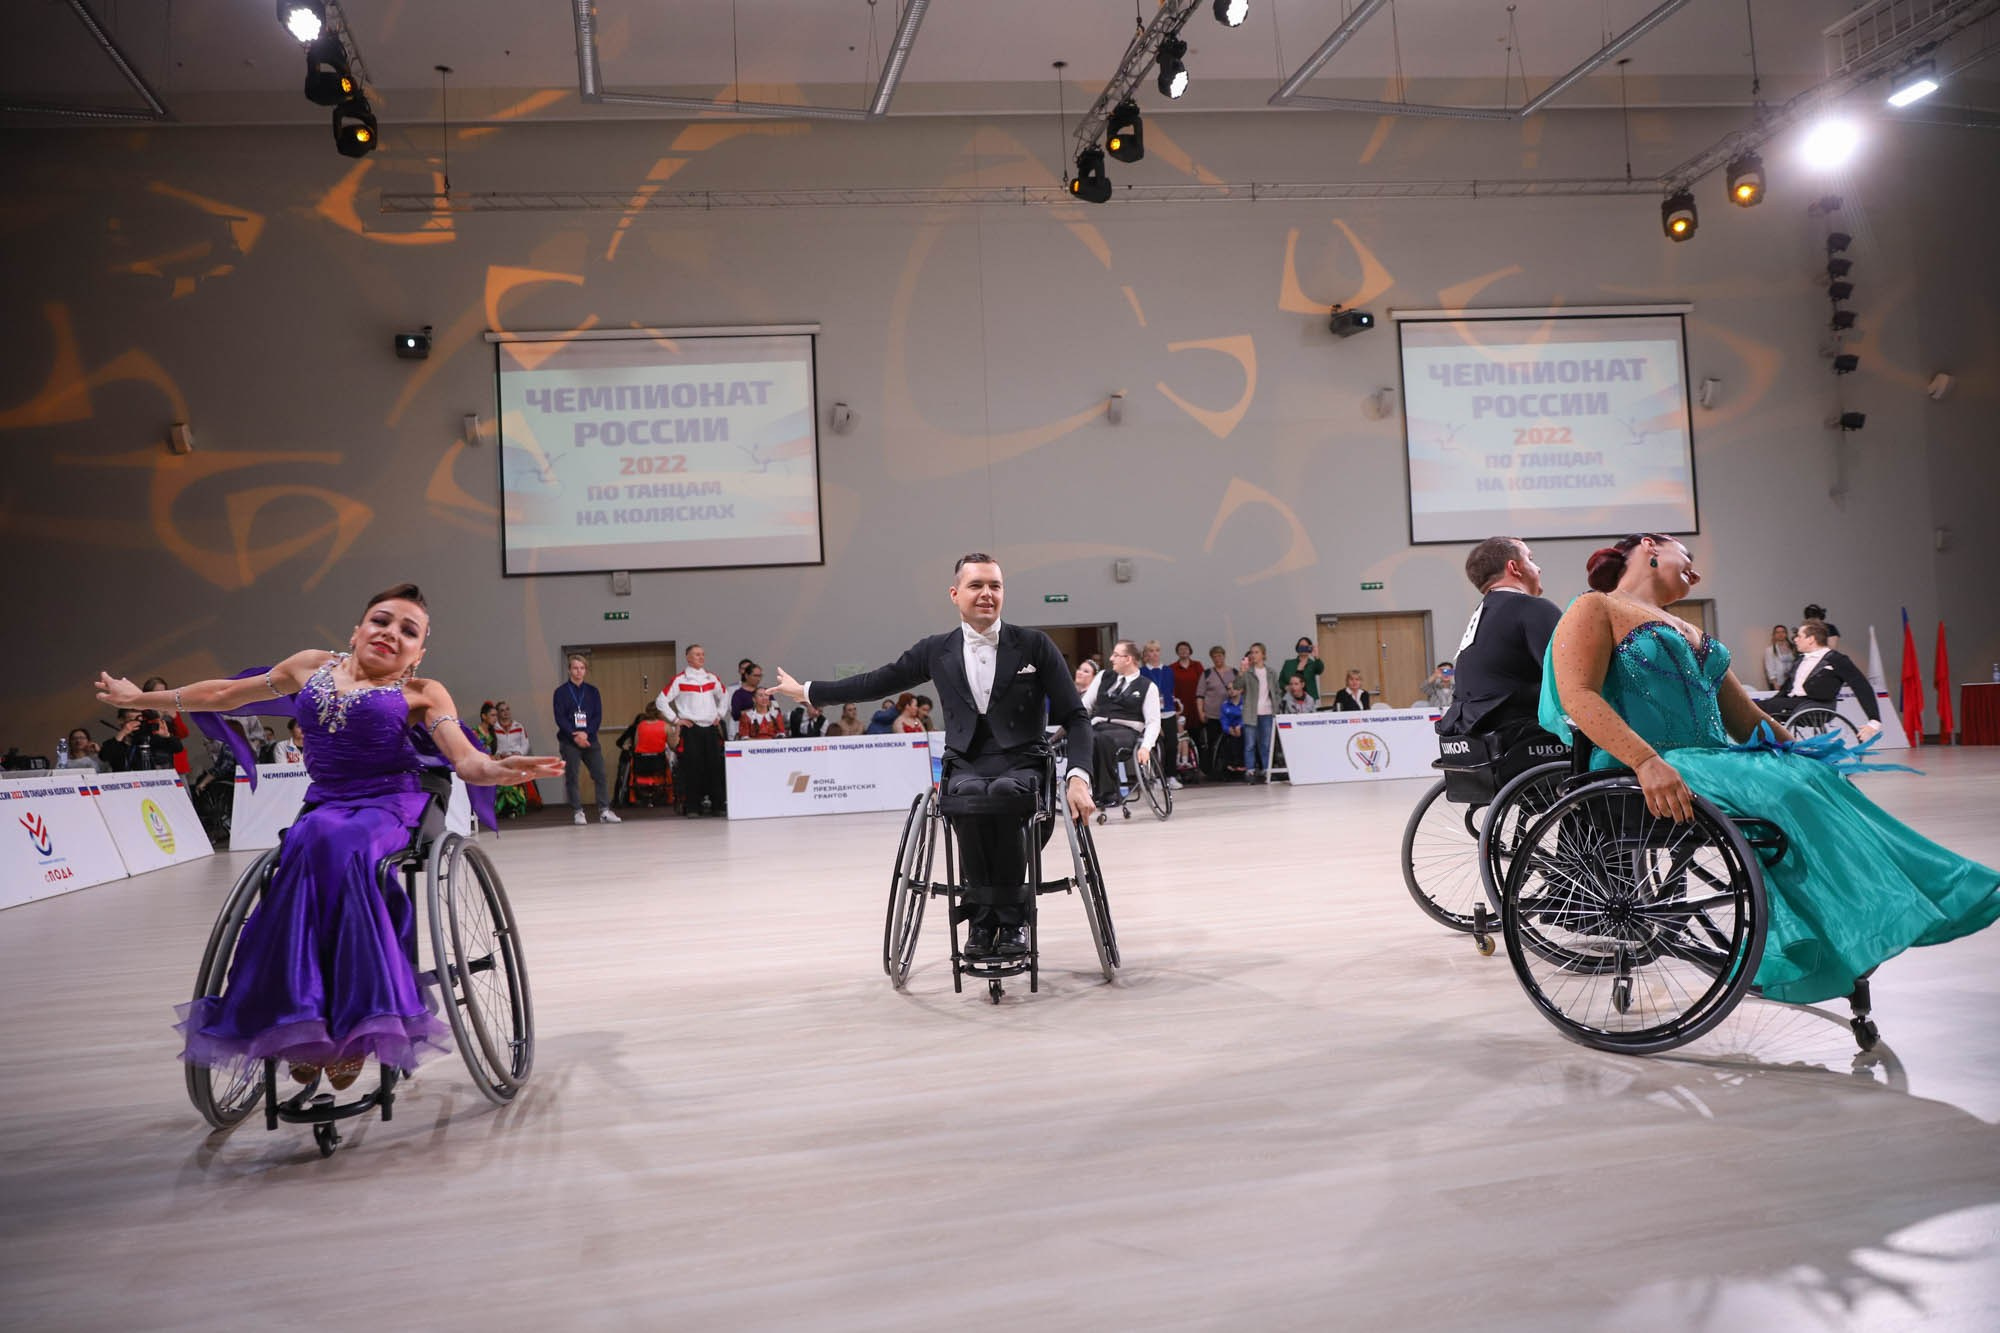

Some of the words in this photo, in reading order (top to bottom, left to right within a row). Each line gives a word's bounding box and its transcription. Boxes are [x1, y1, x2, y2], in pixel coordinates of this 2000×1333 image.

[1428, 358, 1648, 387] ЧЕМПИОНАТ
[525, 381, 774, 413] ЧЕМПИОНАТ
[1472, 391, 1609, 419] РОССИИ
[574, 417, 729, 447] РОССИИ
[1513, 427, 1574, 446] 2022
[619, 455, 688, 475] 2022
[1485, 455, 1513, 469] ПО
[1519, 451, 1603, 468] ТАНЦАМ
[587, 486, 619, 501] ПО
[627, 481, 722, 499] ТАНЦАМ
[1476, 477, 1506, 492] НА
[1509, 473, 1616, 491] КОЛЯСКАХ
[576, 510, 609, 526] НА
[613, 504, 735, 524] КОЛЯСКАХ
[262, 771, 307, 779] ЧЕМПИОНАТ
[813, 792, 848, 800] ГРАНТОВ
